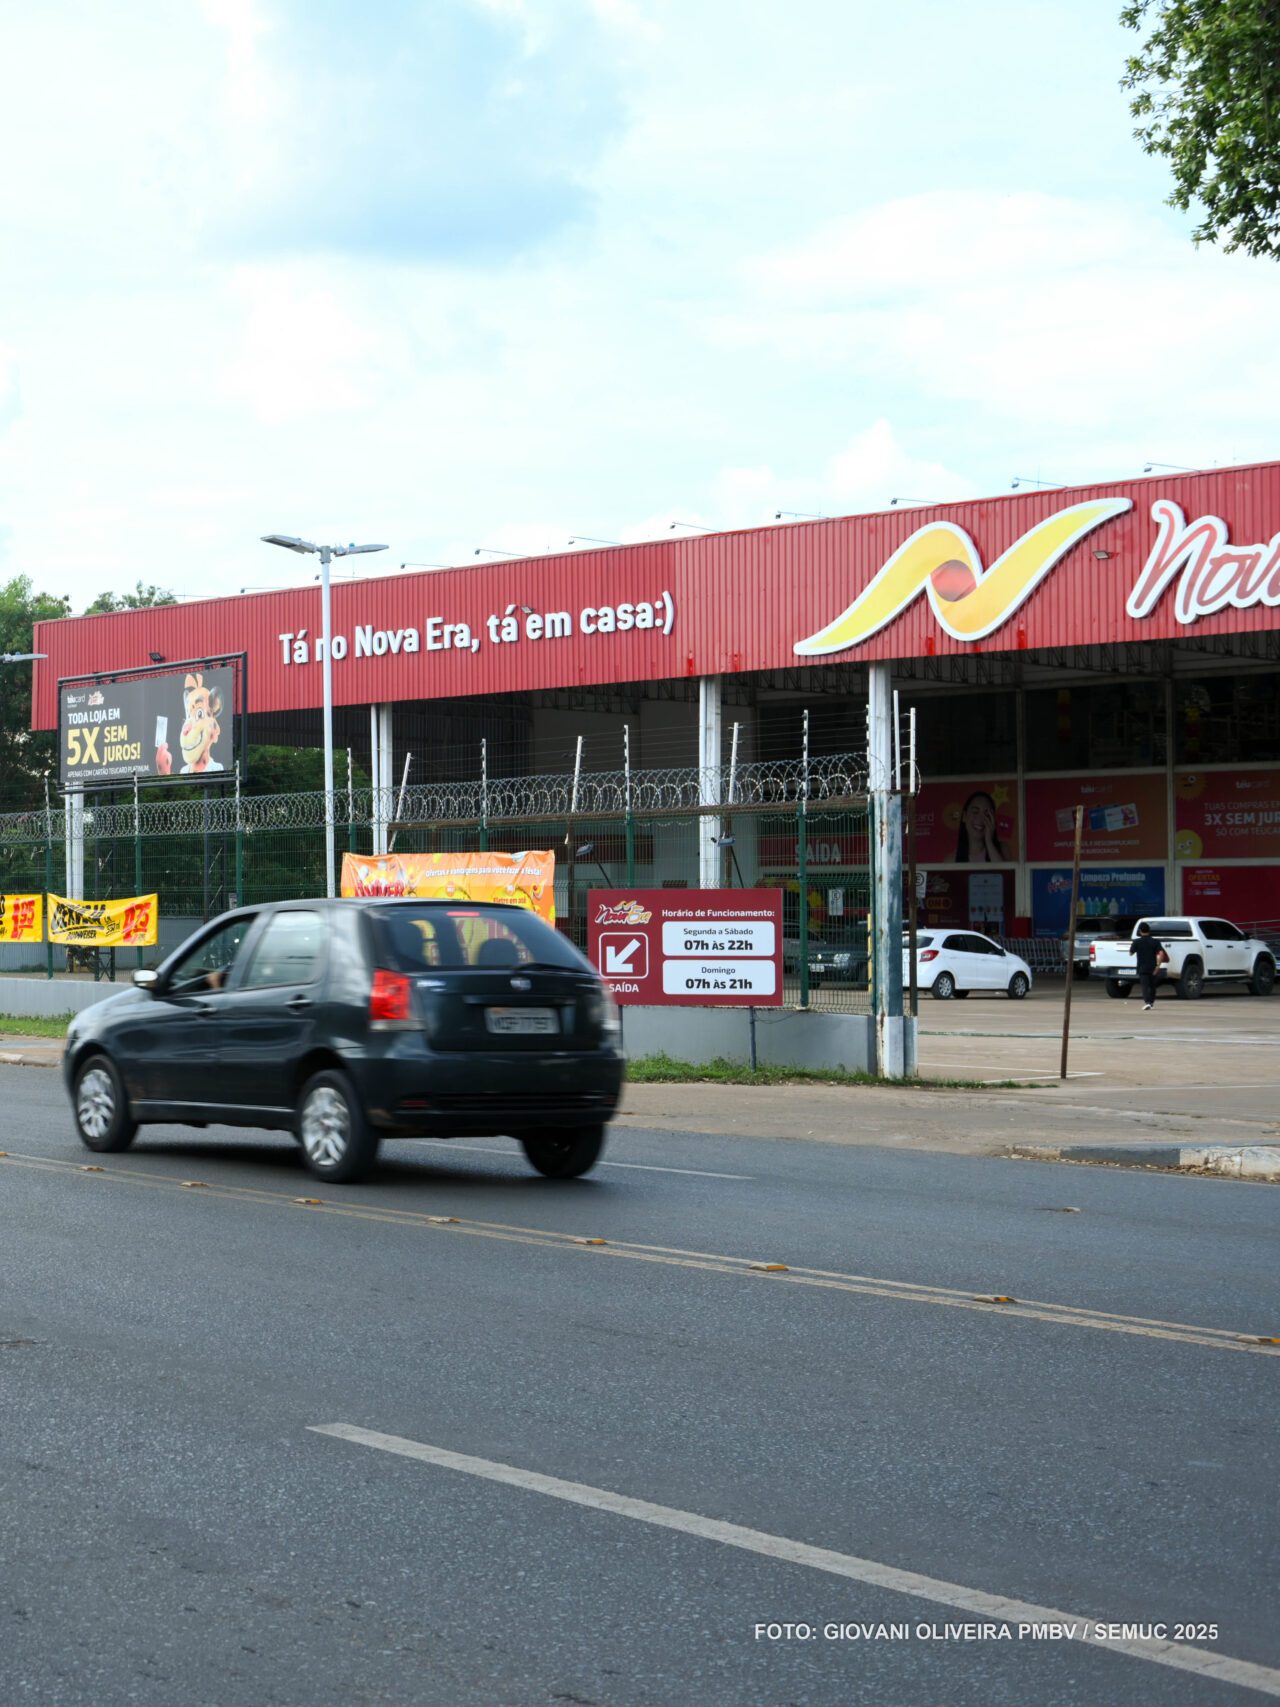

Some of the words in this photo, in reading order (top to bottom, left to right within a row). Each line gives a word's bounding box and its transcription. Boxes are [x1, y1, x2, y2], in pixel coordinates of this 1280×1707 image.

[279, 629, 308, 664] Tá
[316, 636, 347, 662] no
[356, 624, 420, 659] Nova
[427, 617, 479, 653] Era,
[487, 604, 518, 644] tá
[526, 612, 572, 640] em
[68, 712, 88, 724] TODA
[90, 710, 107, 724] LOJA
[108, 708, 120, 720] EM
[104, 725, 127, 743] SEM
[67, 727, 100, 766] 5X
[102, 742, 141, 766] JUROS!
[1204, 813, 1222, 825] 3X
[1225, 812, 1256, 825] SEM
[1229, 827, 1248, 836] COM
[662, 909, 693, 917] Horário
[695, 909, 706, 917] de
[707, 909, 775, 917] Funcionamento:
[683, 928, 716, 936] Segunda
[684, 940, 709, 950] 07h
[728, 940, 753, 950] 22h
[701, 967, 736, 975] Domingo
[608, 982, 639, 992] SAÍDA
[686, 979, 710, 989] 07h
[729, 979, 752, 989] 21h
